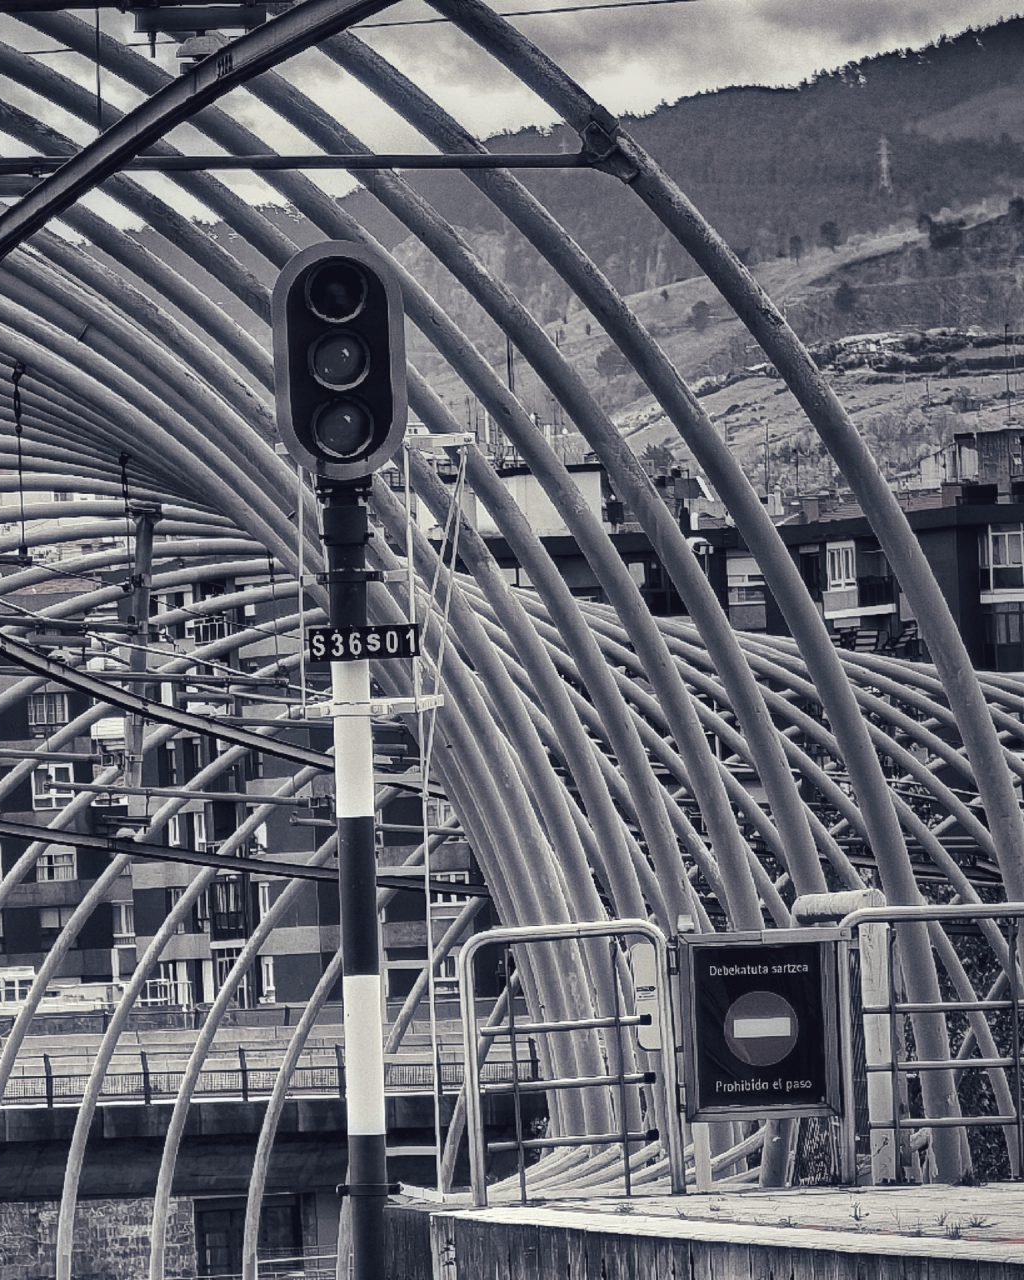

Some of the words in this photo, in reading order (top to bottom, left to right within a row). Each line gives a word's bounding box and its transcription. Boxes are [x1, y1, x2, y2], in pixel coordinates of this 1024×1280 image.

[709, 964, 769, 976] Debekatuta
[771, 963, 809, 974] sartzea
[715, 1078, 769, 1093] Prohibido
[772, 1078, 782, 1090] el
[786, 1080, 813, 1092] paso
